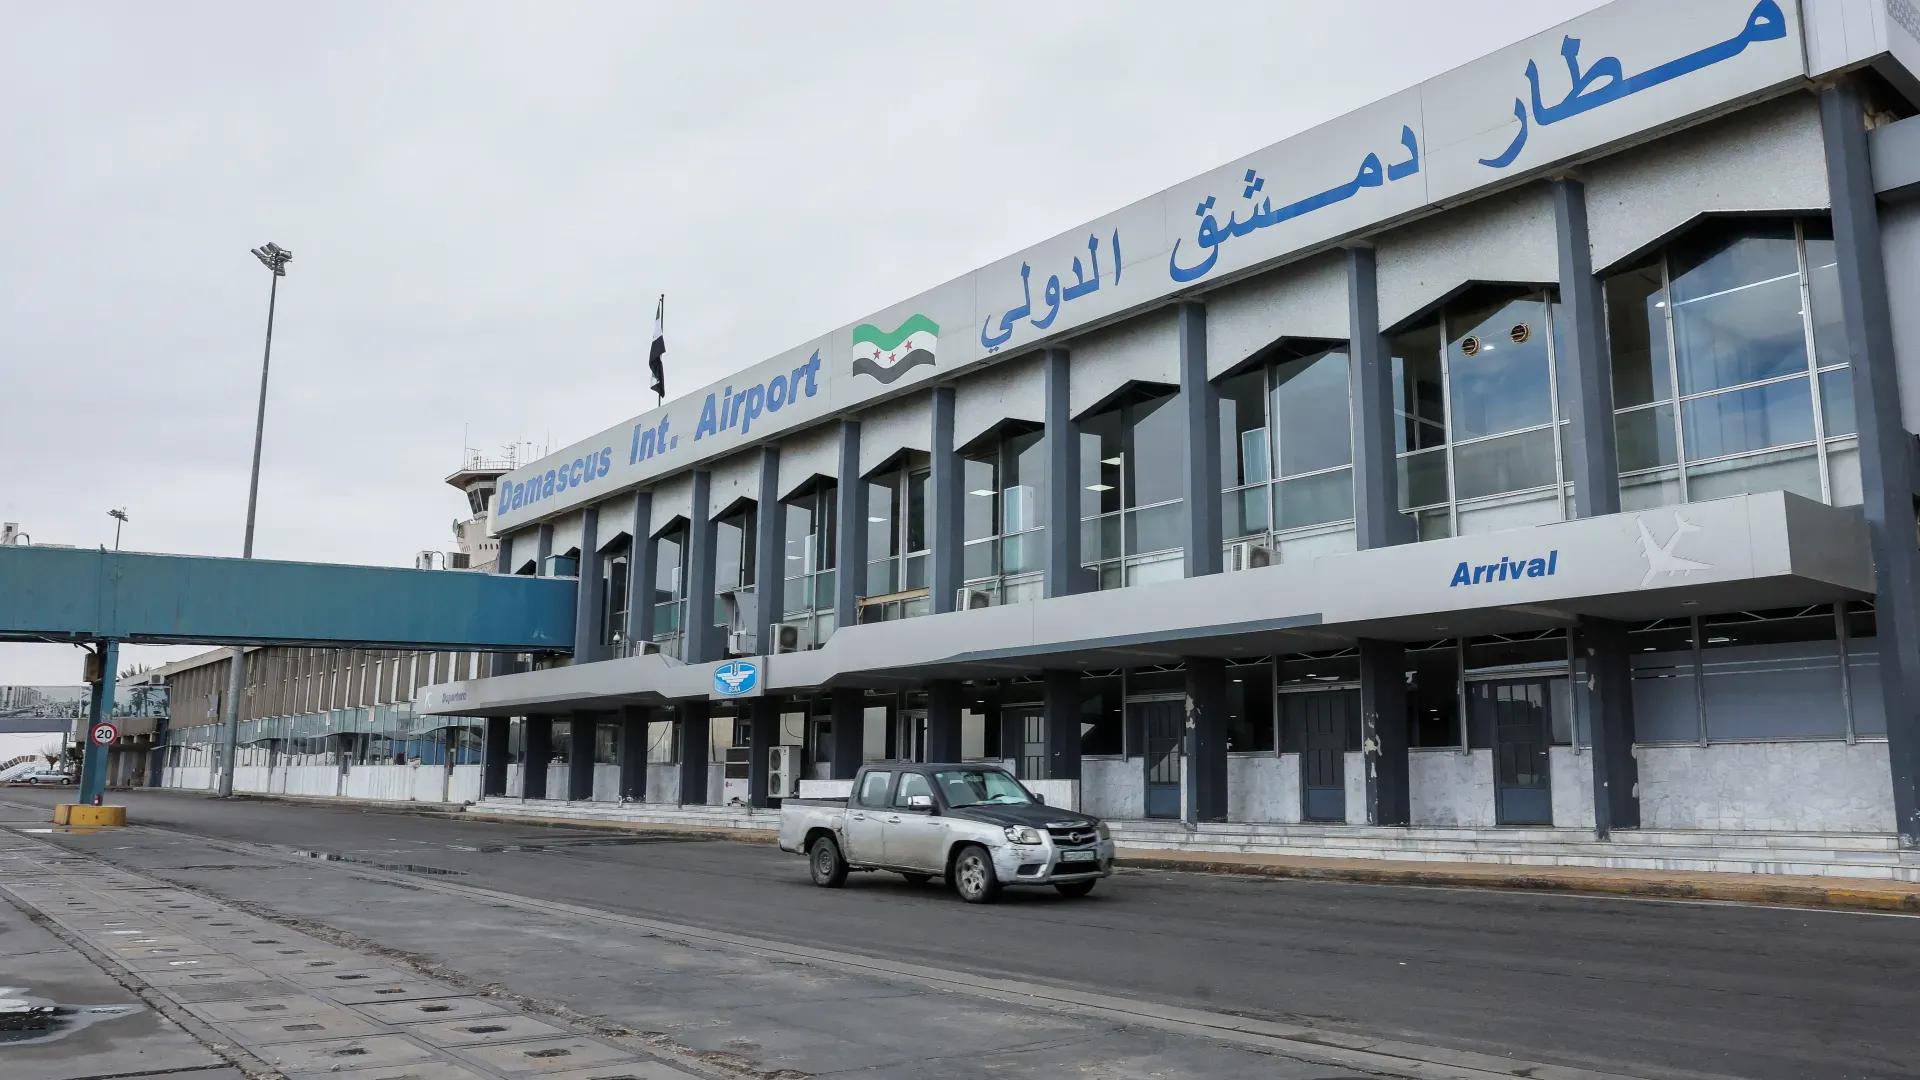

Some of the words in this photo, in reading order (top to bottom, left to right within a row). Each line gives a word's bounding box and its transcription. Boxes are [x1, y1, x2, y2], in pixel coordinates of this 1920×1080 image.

[1478, 0, 1787, 169] مطار
[1169, 124, 1419, 283] دمشق
[980, 226, 1123, 354] الدولي
[497, 445, 612, 516] Damascus
[629, 413, 679, 466] Int.
[694, 348, 822, 442] Airport
[1450, 549, 1558, 588] Arrival
[96, 729, 113, 739] 20
